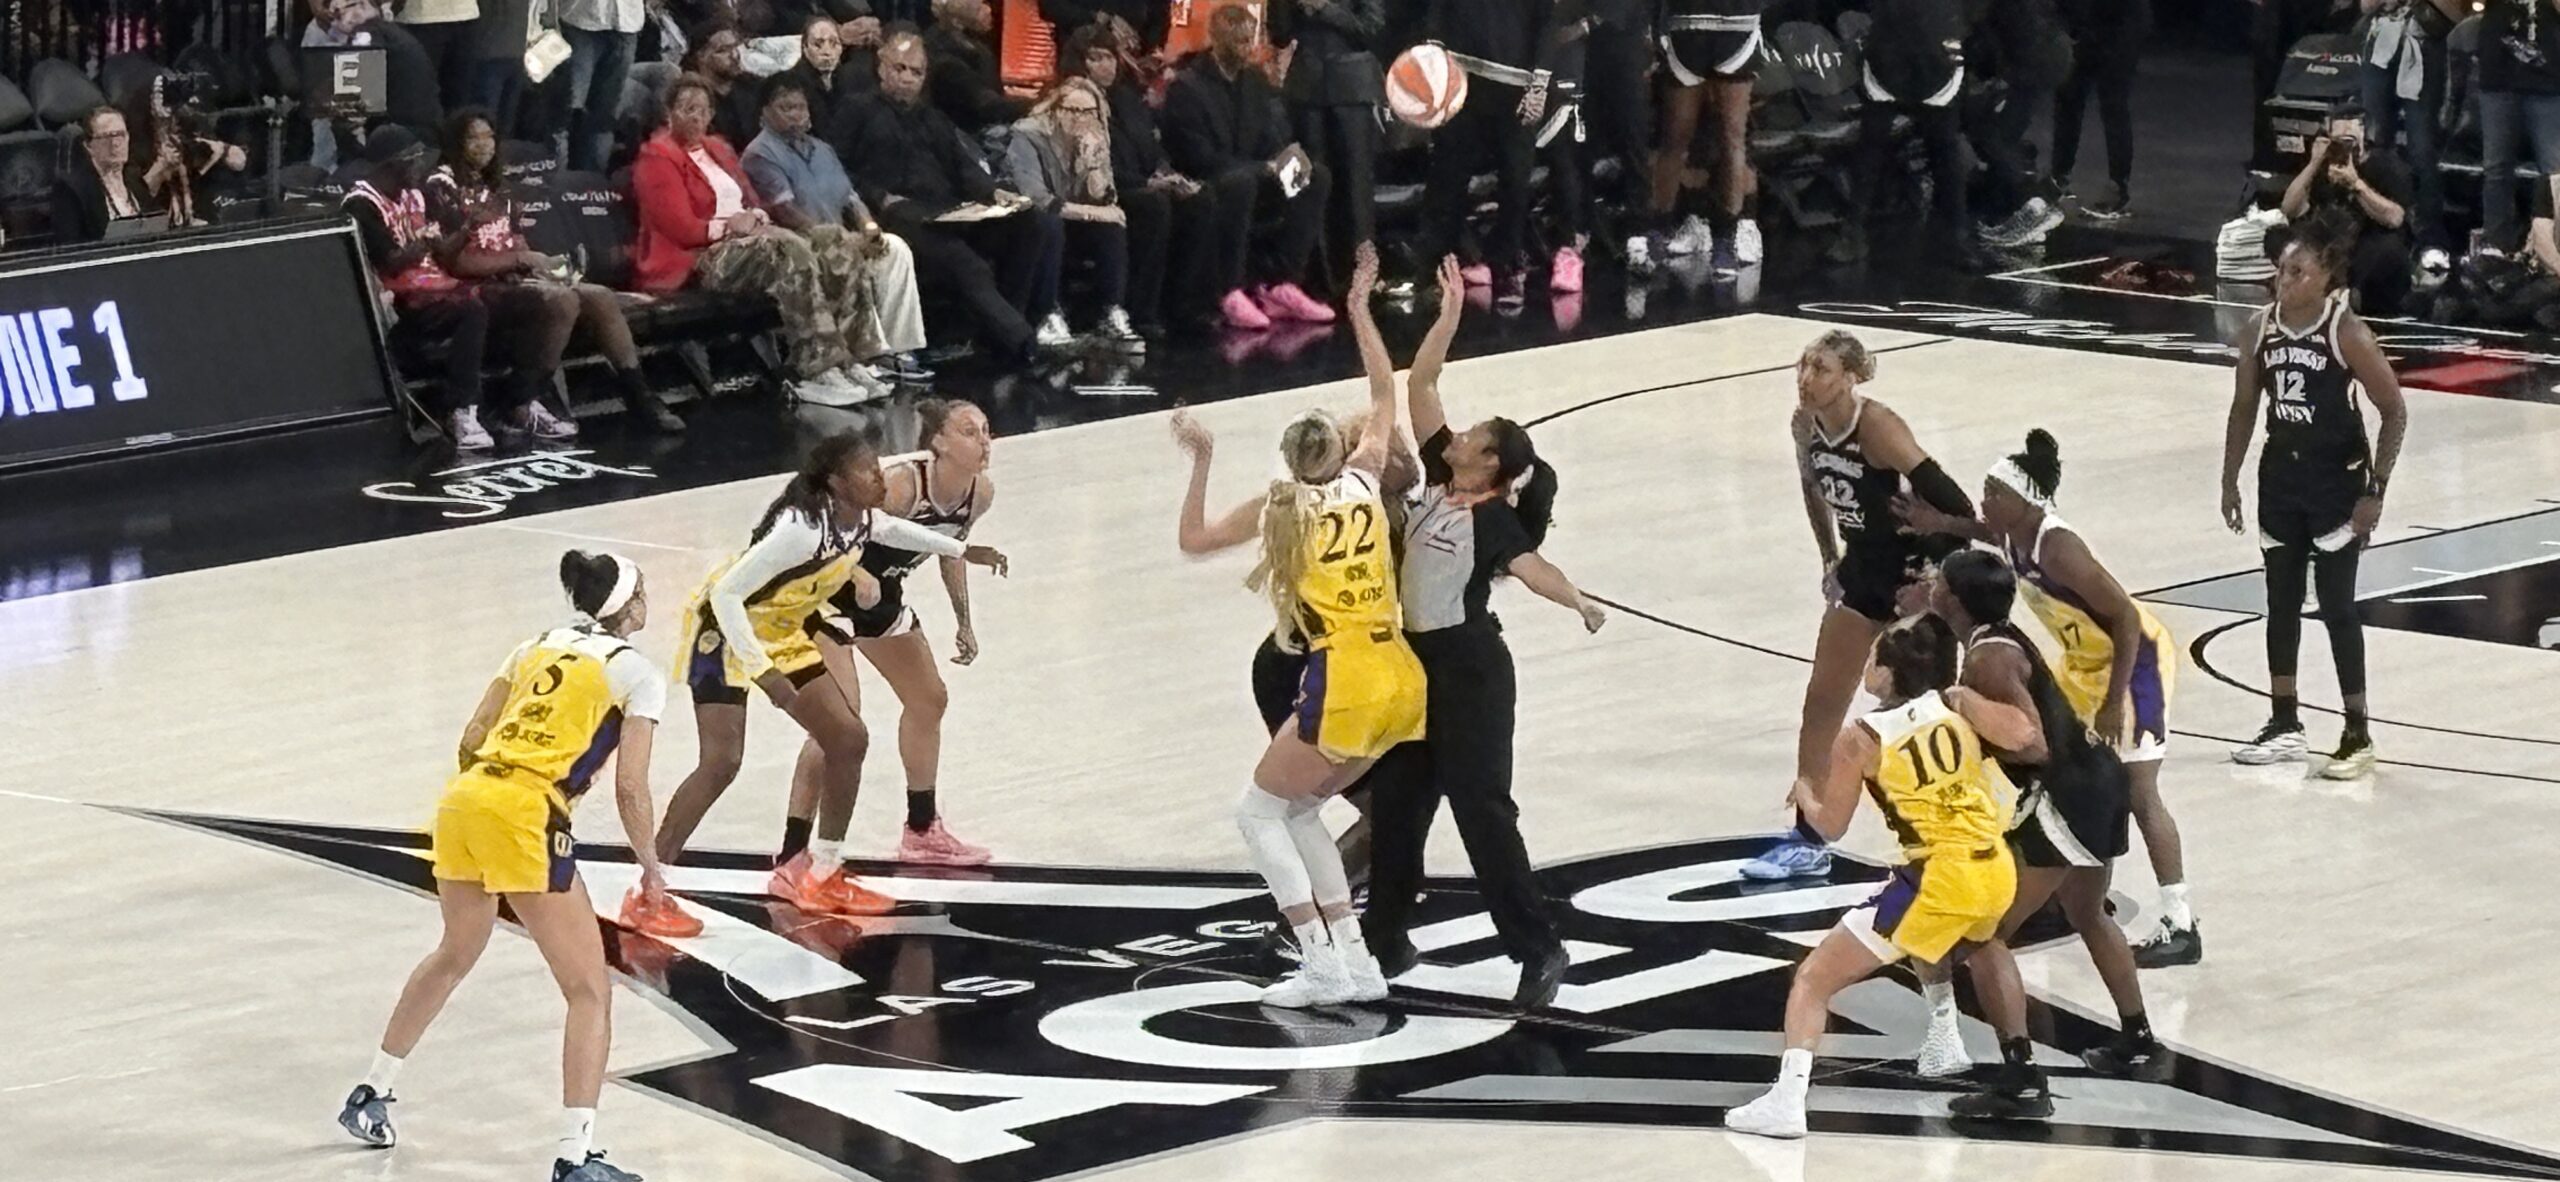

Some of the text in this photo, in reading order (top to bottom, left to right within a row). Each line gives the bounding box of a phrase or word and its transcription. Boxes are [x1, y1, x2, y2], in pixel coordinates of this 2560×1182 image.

[0, 300, 148, 417] NE 1
[2275, 369, 2307, 402] 12
[362, 449, 657, 518] Secret
[1319, 503, 1375, 564] 22
[533, 653, 578, 696] 5
[1898, 723, 1962, 792] 10
[783, 919, 1280, 1030] LAS VEG
